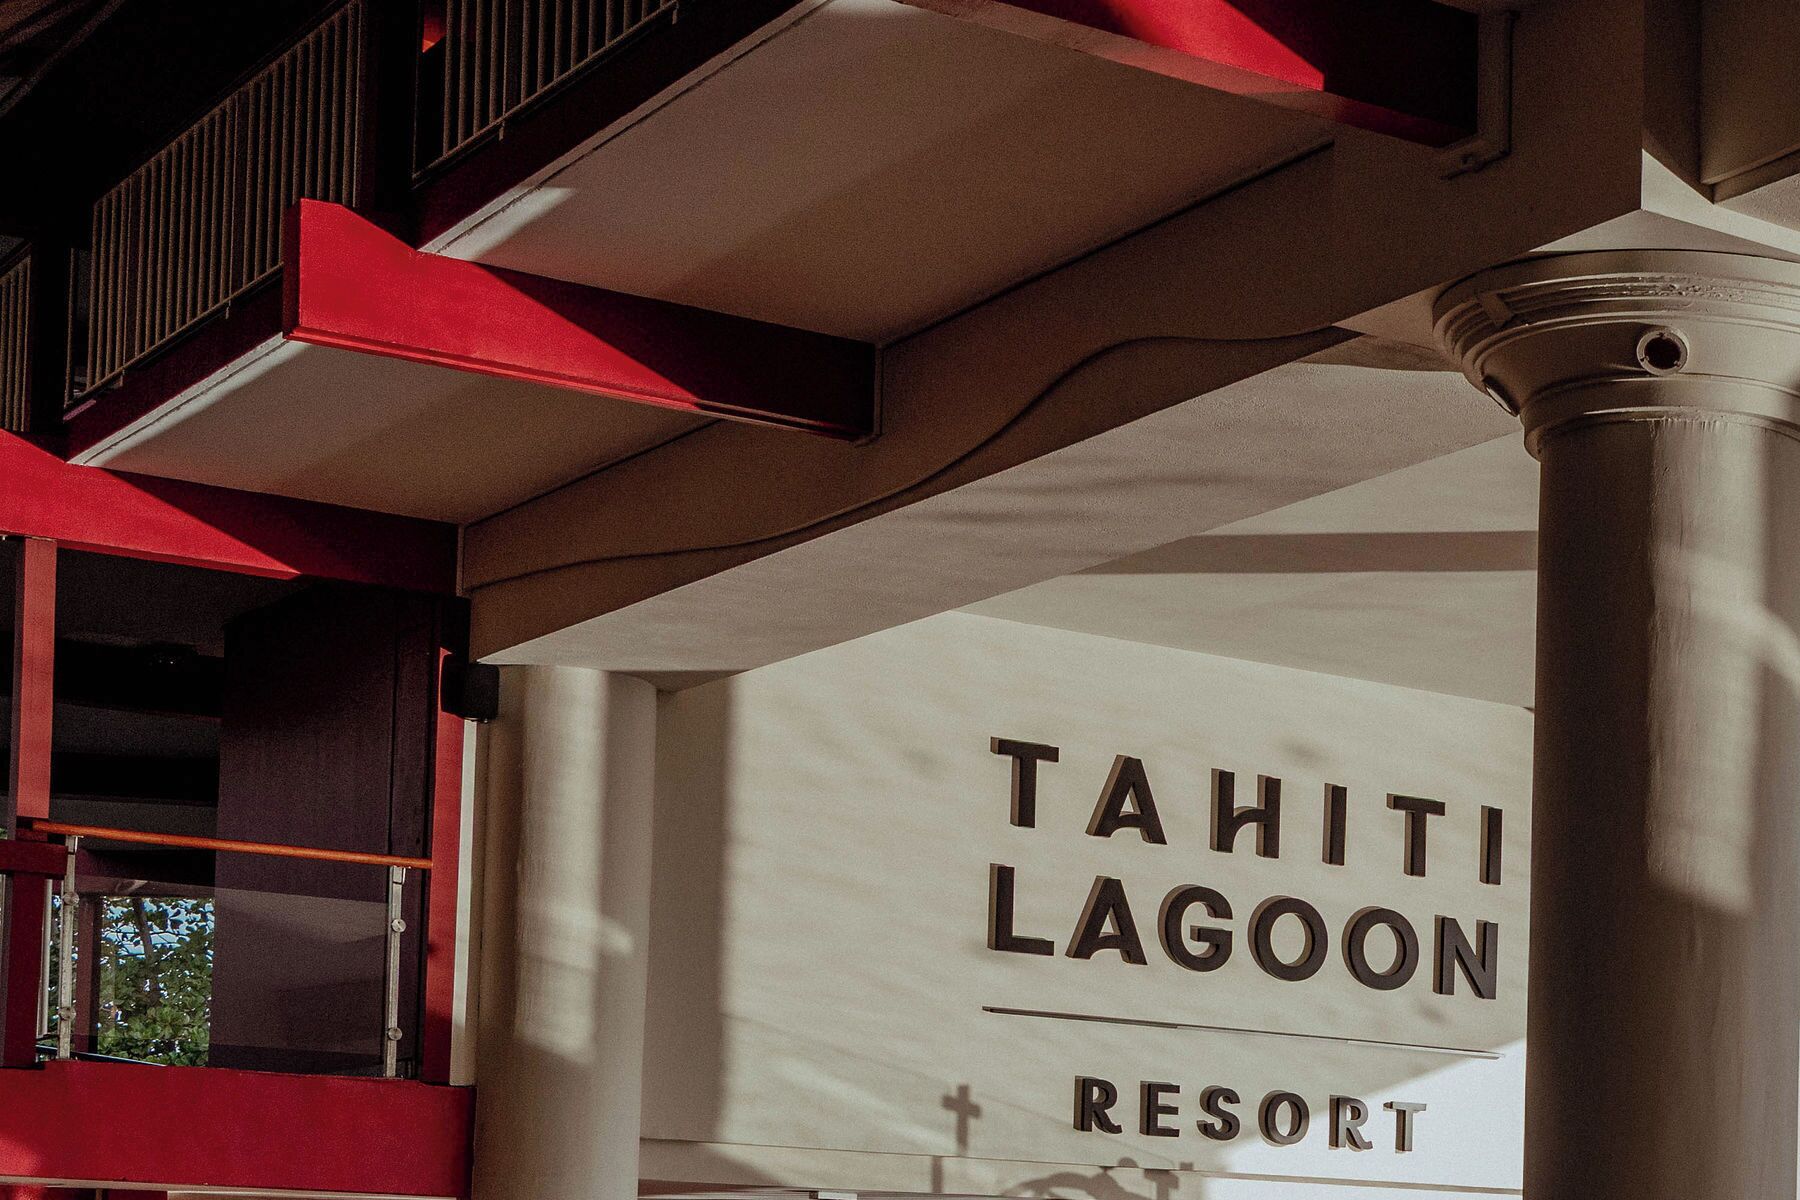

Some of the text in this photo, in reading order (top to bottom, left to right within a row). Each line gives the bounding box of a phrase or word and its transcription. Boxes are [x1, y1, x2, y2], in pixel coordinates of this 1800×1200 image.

[990, 736, 1503, 886] TAHITI
[987, 863, 1498, 1000] LAGOON
[1073, 1075, 1427, 1153] RESORT
